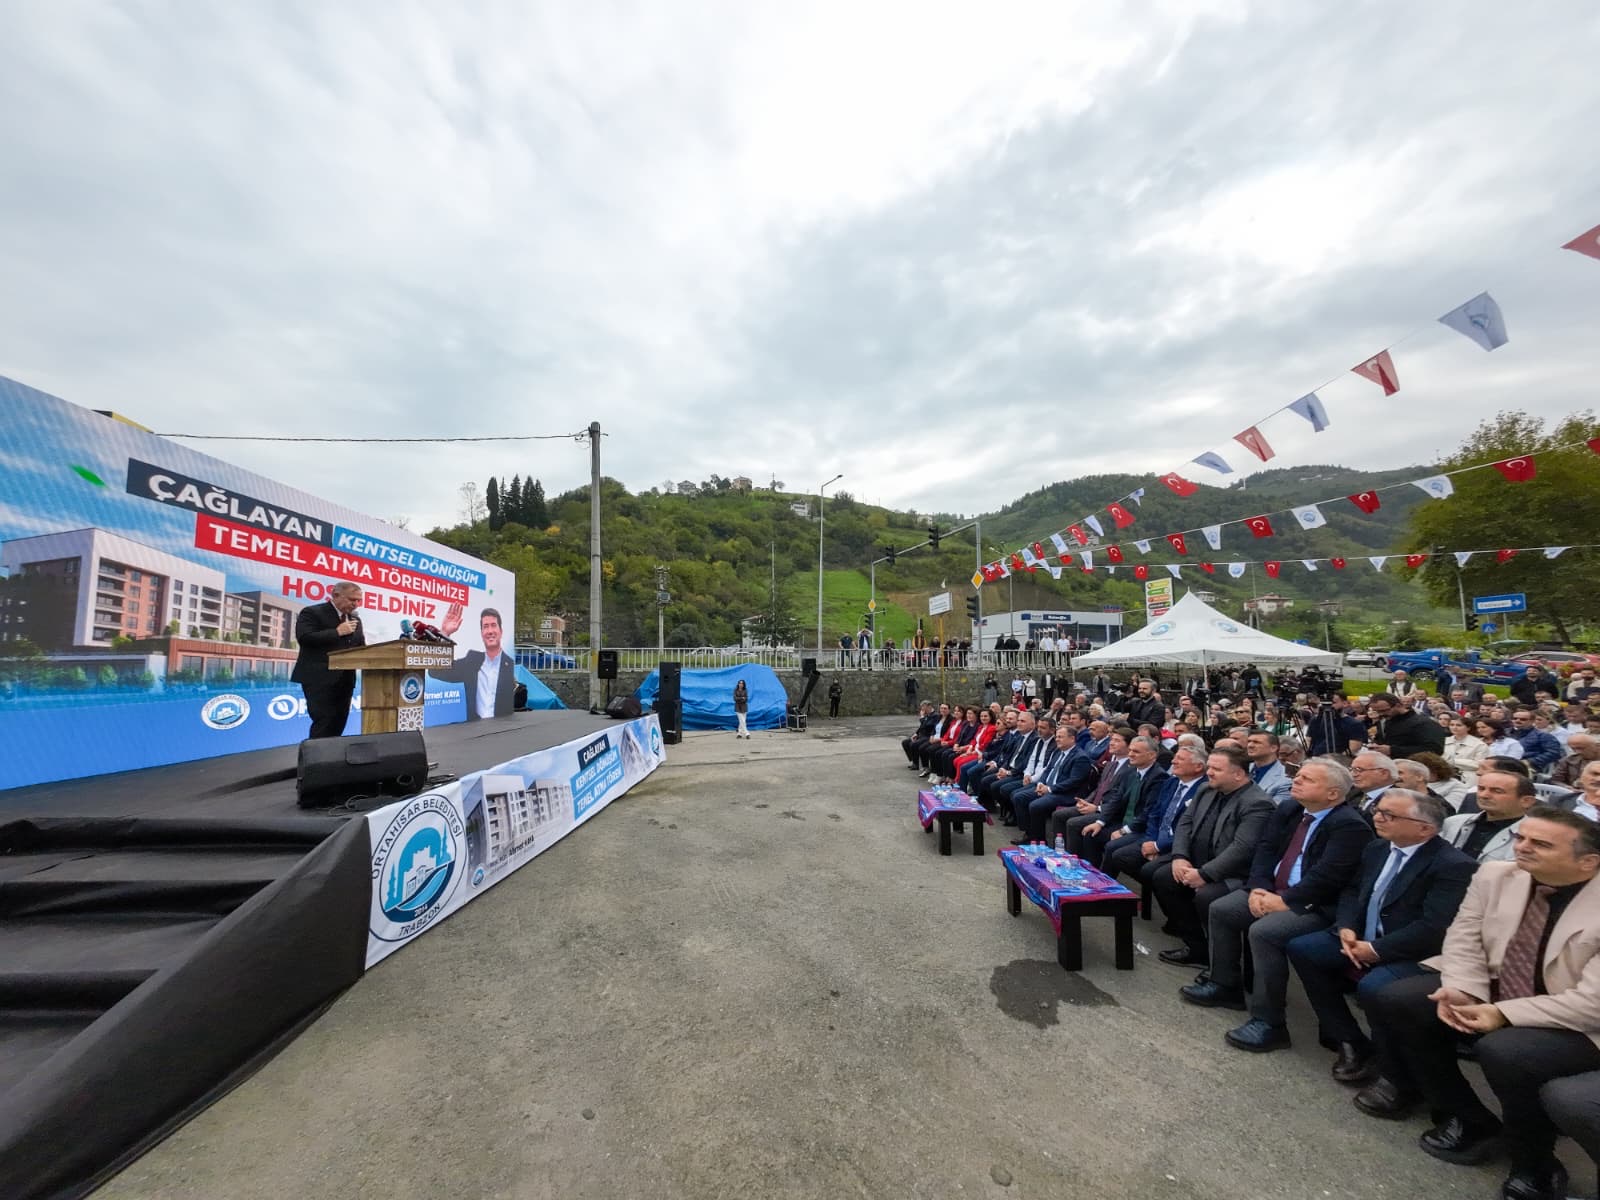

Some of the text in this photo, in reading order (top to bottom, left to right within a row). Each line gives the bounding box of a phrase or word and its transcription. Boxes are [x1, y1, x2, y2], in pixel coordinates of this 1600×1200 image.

[148, 474, 322, 541] ÇAĞLAYAN
[209, 523, 465, 601] TEMEL ATMA TÖRENİMİZE
[338, 533, 479, 585] KENTSEL DÖNÜŞÜM
[357, 591, 435, 619] ELDİNİZ
[371, 798, 463, 880] ORTAHİSAR BELEDİYESİ
[399, 903, 441, 936] TRABZON
